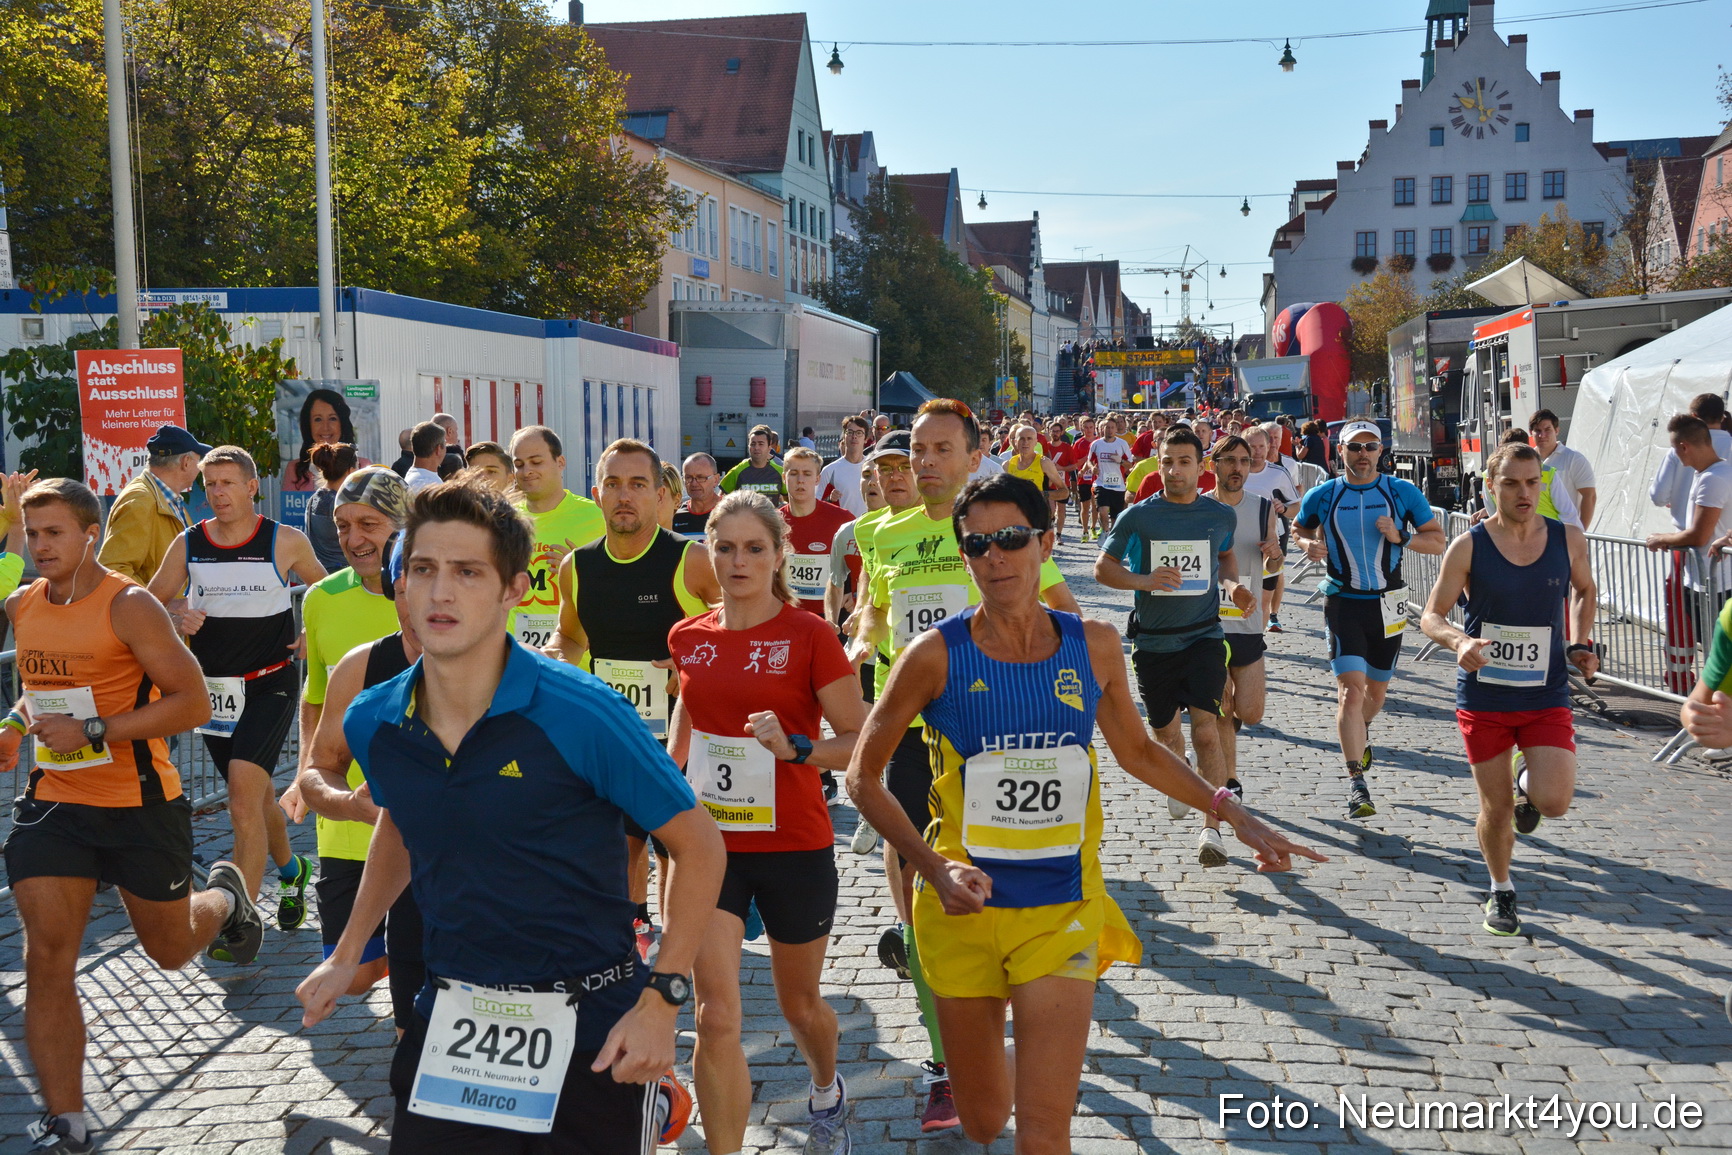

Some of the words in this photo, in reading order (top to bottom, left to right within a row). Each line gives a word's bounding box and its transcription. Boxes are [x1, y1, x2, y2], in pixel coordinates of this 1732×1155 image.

[161, 294, 175, 302] DIXI
[213, 294, 220, 302] 80
[1126, 353, 1162, 362] START
[86, 359, 177, 376] Abschluss
[87, 376, 118, 387] statt
[89, 386, 178, 401] Ausschluss!
[105, 410, 130, 419] Mehr
[132, 408, 161, 418] Lehrer
[163, 407, 175, 417] für
[101, 420, 140, 430] kleinere
[141, 419, 175, 428] Klassen
[740, 483, 779, 492] BOCK
[1168, 544, 1193, 552] BOCK
[1160, 555, 1201, 572] 3124
[789, 564, 823, 581] 2487
[205, 585, 232, 593] Autohaus
[908, 592, 944, 604] BOCK
[528, 619, 555, 627] BOCK
[1500, 630, 1531, 639] BOCK
[763, 639, 791, 647] Wolfstein
[1489, 640, 1539, 662] 3013
[680, 655, 702, 666] Spitz
[26, 658, 74, 677] OEXL
[612, 668, 644, 678] BOCK
[708, 743, 745, 757] BOCK
[1004, 757, 1057, 770] BOCK
[499, 769, 523, 778] adidas
[716, 763, 732, 791] 3
[701, 791, 717, 801] PARTL
[717, 795, 746, 803] Neumarkt
[996, 778, 1062, 812] 326
[991, 814, 1017, 825] PARTL
[1018, 816, 1053, 825] Neumarkt
[473, 997, 533, 1017] BOCK
[446, 1018, 552, 1070] 2420
[451, 1065, 482, 1078] PARTL
[484, 1071, 526, 1084] Neumarkt
[460, 1087, 517, 1111] Marco
